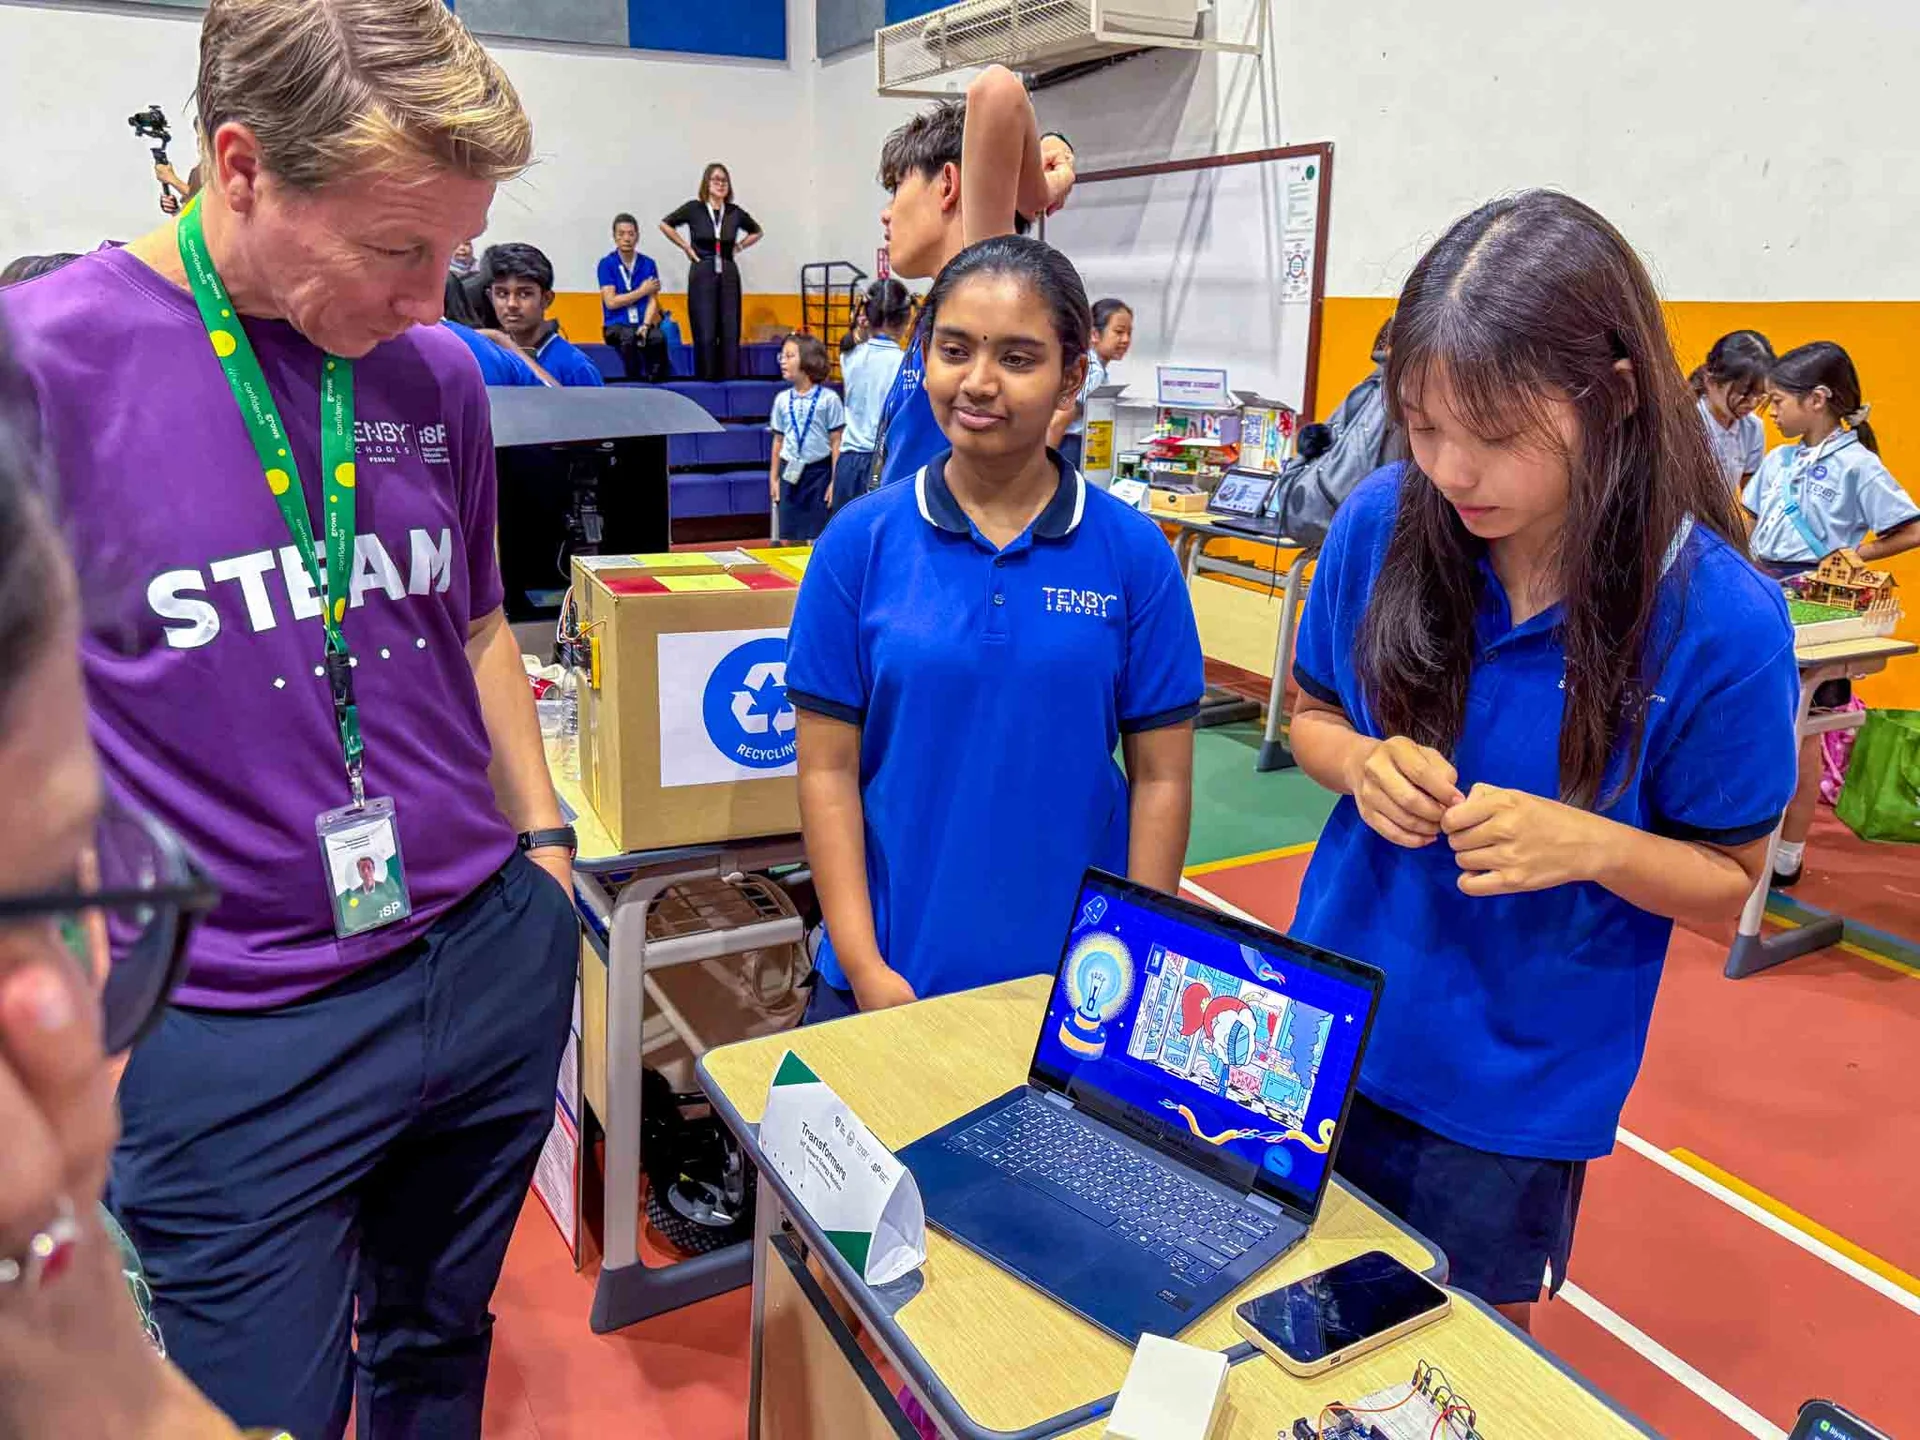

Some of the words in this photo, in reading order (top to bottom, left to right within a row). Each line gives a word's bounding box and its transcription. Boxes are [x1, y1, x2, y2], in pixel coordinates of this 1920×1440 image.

[206, 273, 222, 300] grows
[243, 381, 265, 426] confidence
[265, 413, 281, 439] grows
[353, 421, 406, 444] ENBY
[354, 445, 411, 455] CHOOLS
[330, 511, 338, 538] grows
[147, 527, 453, 649] STEAM
[1042, 586, 1111, 611] TENBY
[1046, 604, 1107, 618] SCHOOLS
[800, 1121, 847, 1181] Transformers
